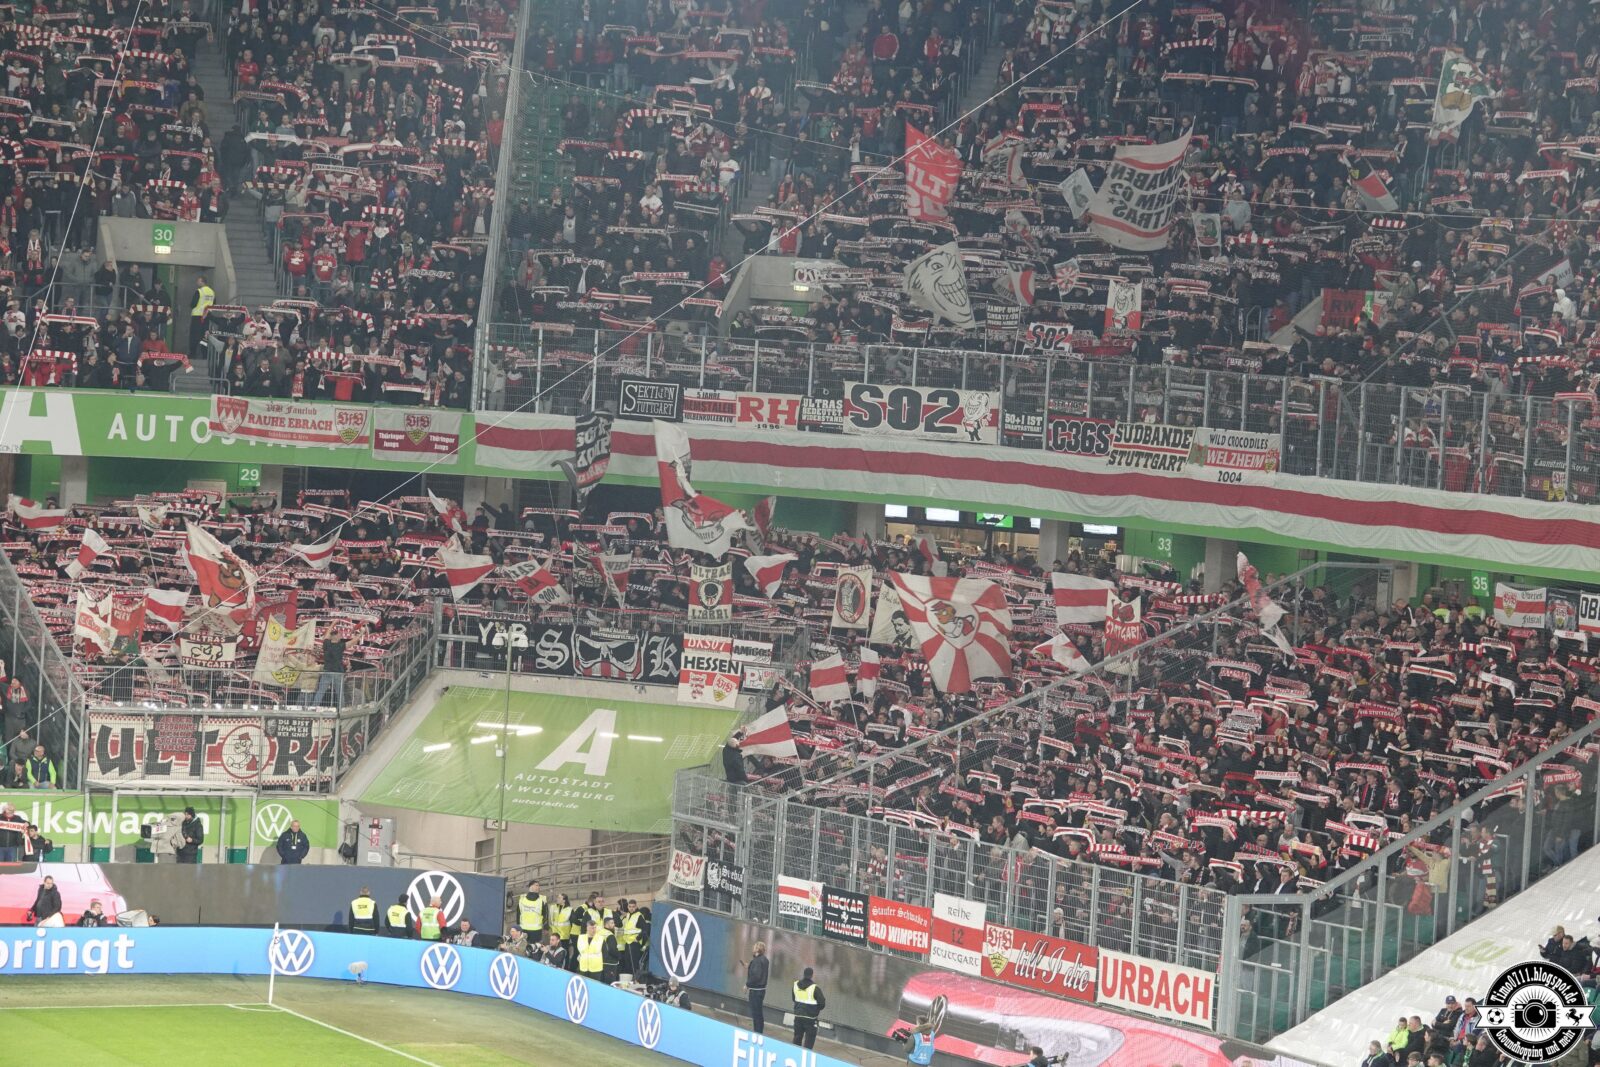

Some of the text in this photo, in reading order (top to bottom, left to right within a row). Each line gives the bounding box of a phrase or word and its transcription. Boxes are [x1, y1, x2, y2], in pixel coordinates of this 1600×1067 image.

[154, 228, 172, 241] 30
[738, 396, 800, 426] RH
[802, 397, 843, 409] ULTRAS
[801, 414, 843, 424] WIDERSTAND
[802, 407, 843, 417] BEDEUTET
[1026, 415, 1043, 426] IST
[247, 413, 334, 432] RAUHE EBRACH
[1051, 418, 1113, 455] C36S
[1209, 433, 1269, 451] WILD CROCODILES
[1107, 450, 1186, 472] STUTTGART
[1206, 449, 1265, 468] WELZHEIM
[240, 468, 260, 481] 29
[1158, 537, 1171, 551] 33
[1473, 576, 1488, 590] 35
[189, 633, 226, 643] ULTRAS
[182, 656, 233, 669] STUTTGART
[684, 655, 740, 675] HESSEN
[277, 725, 309, 733] IMMER
[535, 708, 617, 776] A
[514, 772, 613, 789] AUTOSTADT
[518, 785, 615, 801] WOLFSBURG
[511, 798, 579, 809] autostadt.de
[778, 900, 822, 919] OBERSCHWABEN
[827, 894, 864, 915] NECKAR
[824, 919, 865, 938] HALUNKEN
[869, 919, 929, 949] BAD WIMPFEN
[951, 928, 964, 945] 12
[1014, 939, 1049, 980] till
[1063, 952, 1089, 993] die
[1101, 955, 1211, 1020] URBACH
